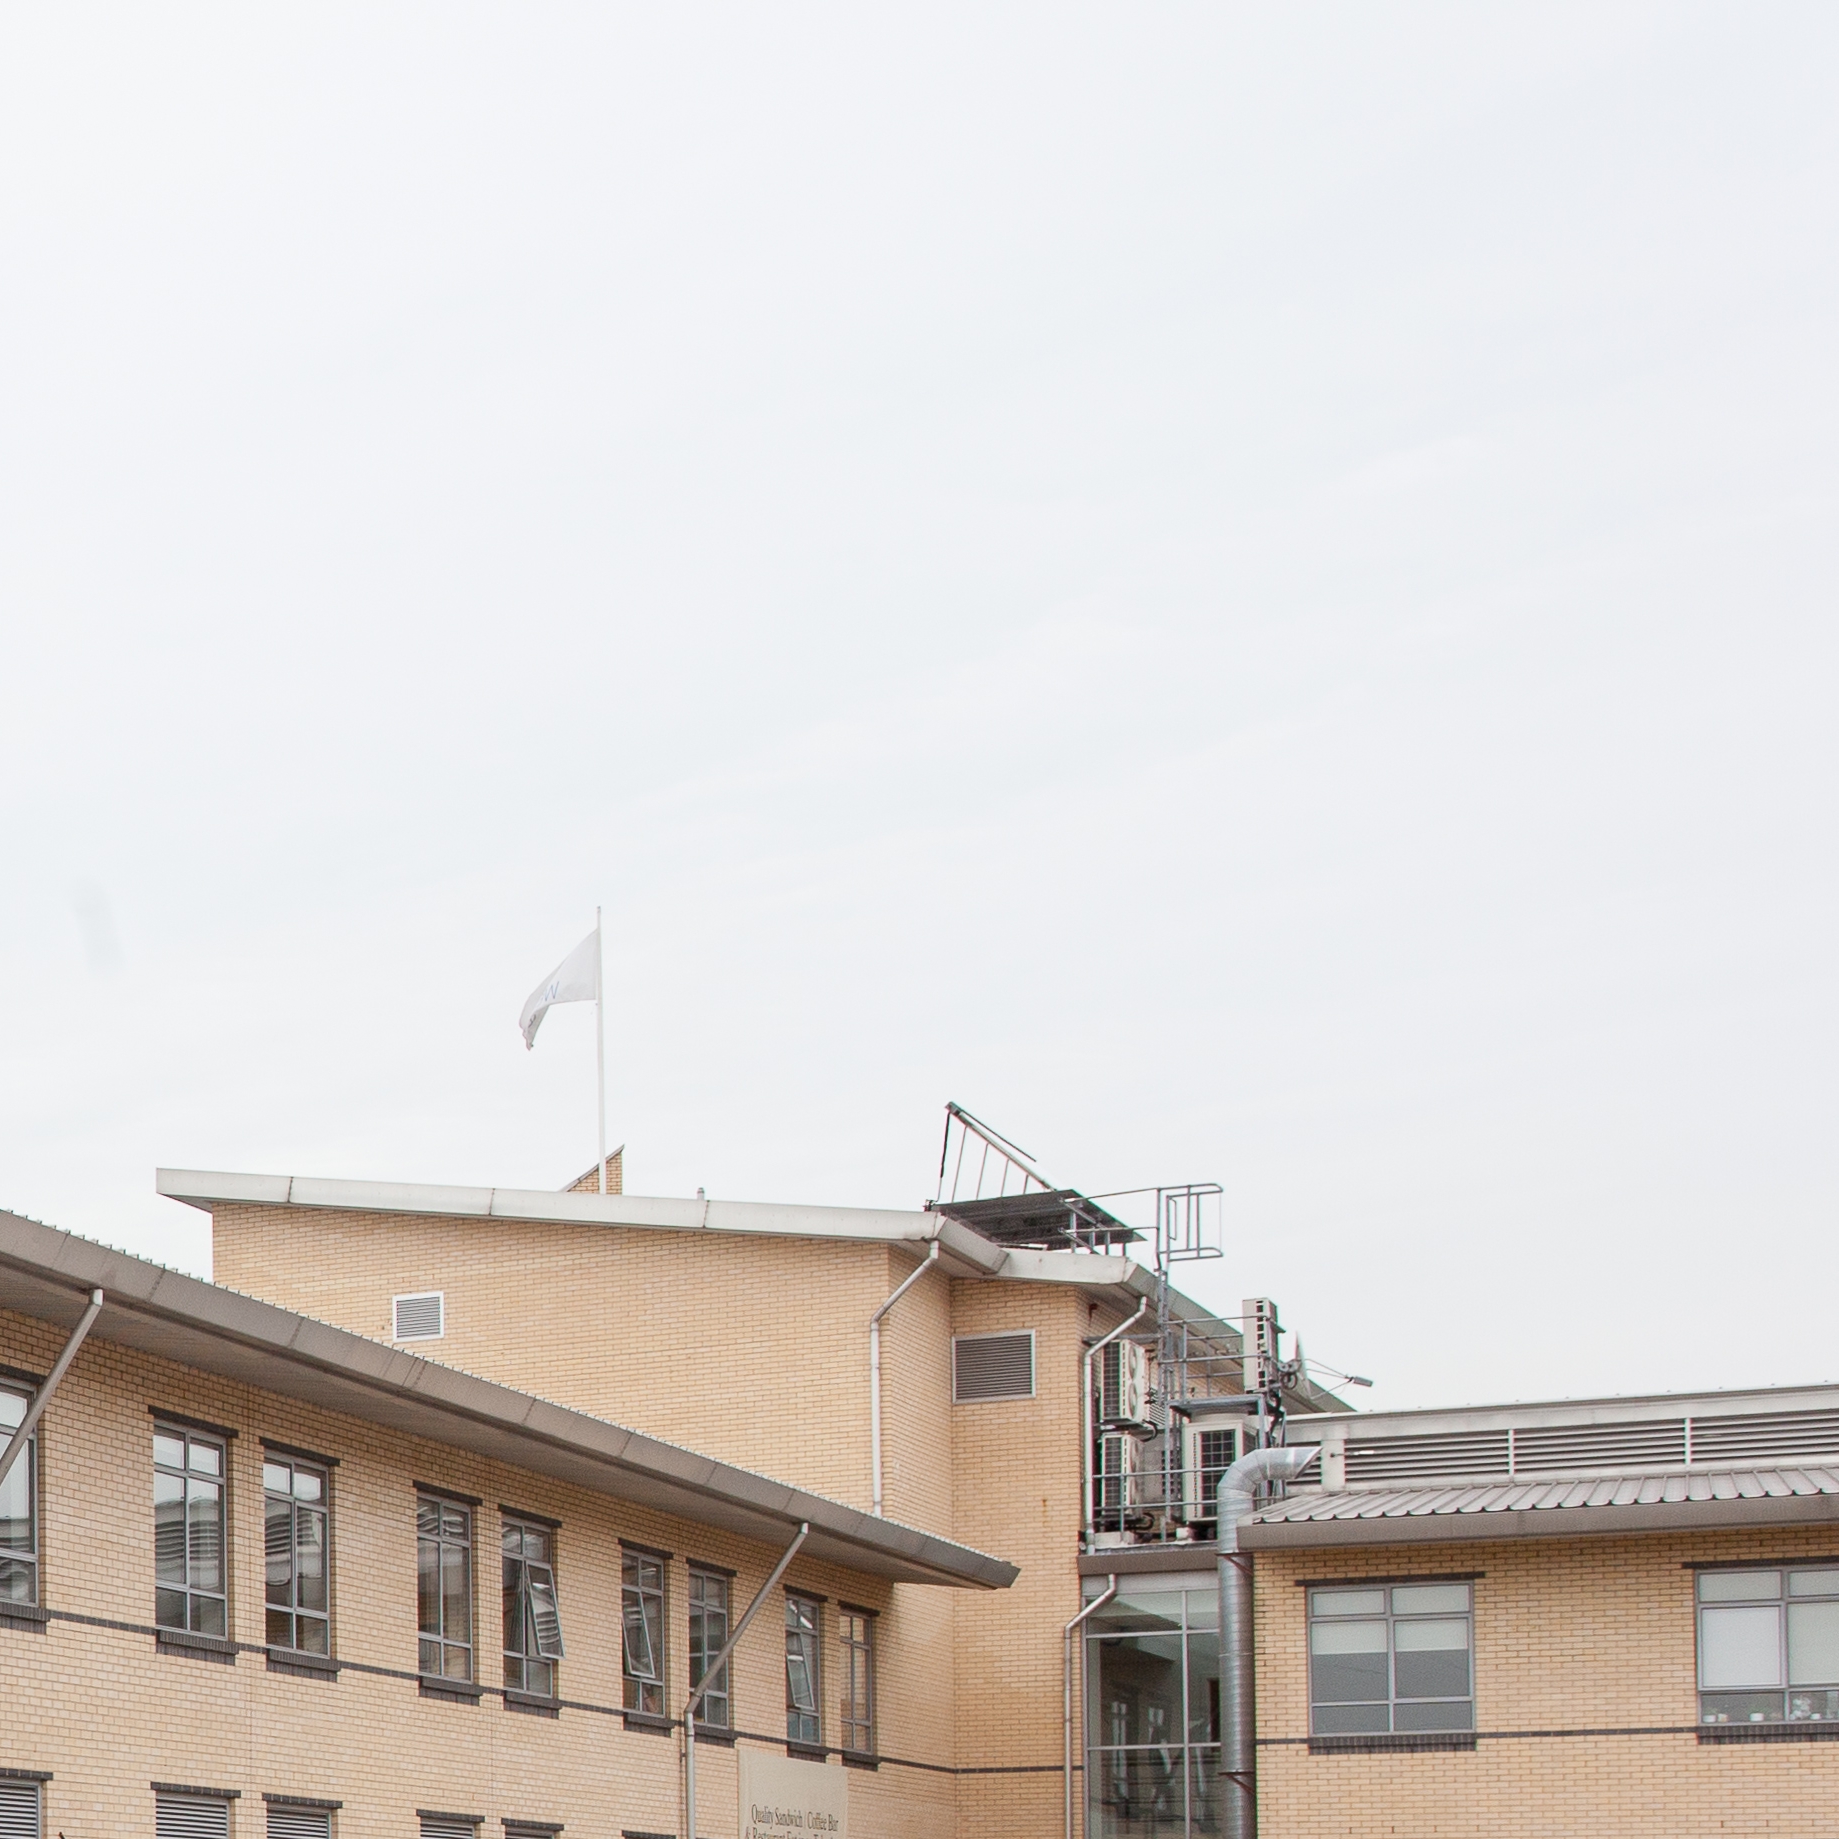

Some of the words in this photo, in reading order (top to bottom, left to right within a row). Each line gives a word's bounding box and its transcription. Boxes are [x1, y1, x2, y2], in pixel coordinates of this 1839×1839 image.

[751, 1804, 773, 1829] Quality
[775, 1807, 803, 1828] Sandwich
[807, 1811, 827, 1831] Coffee
[828, 1813, 839, 1832] Bar
